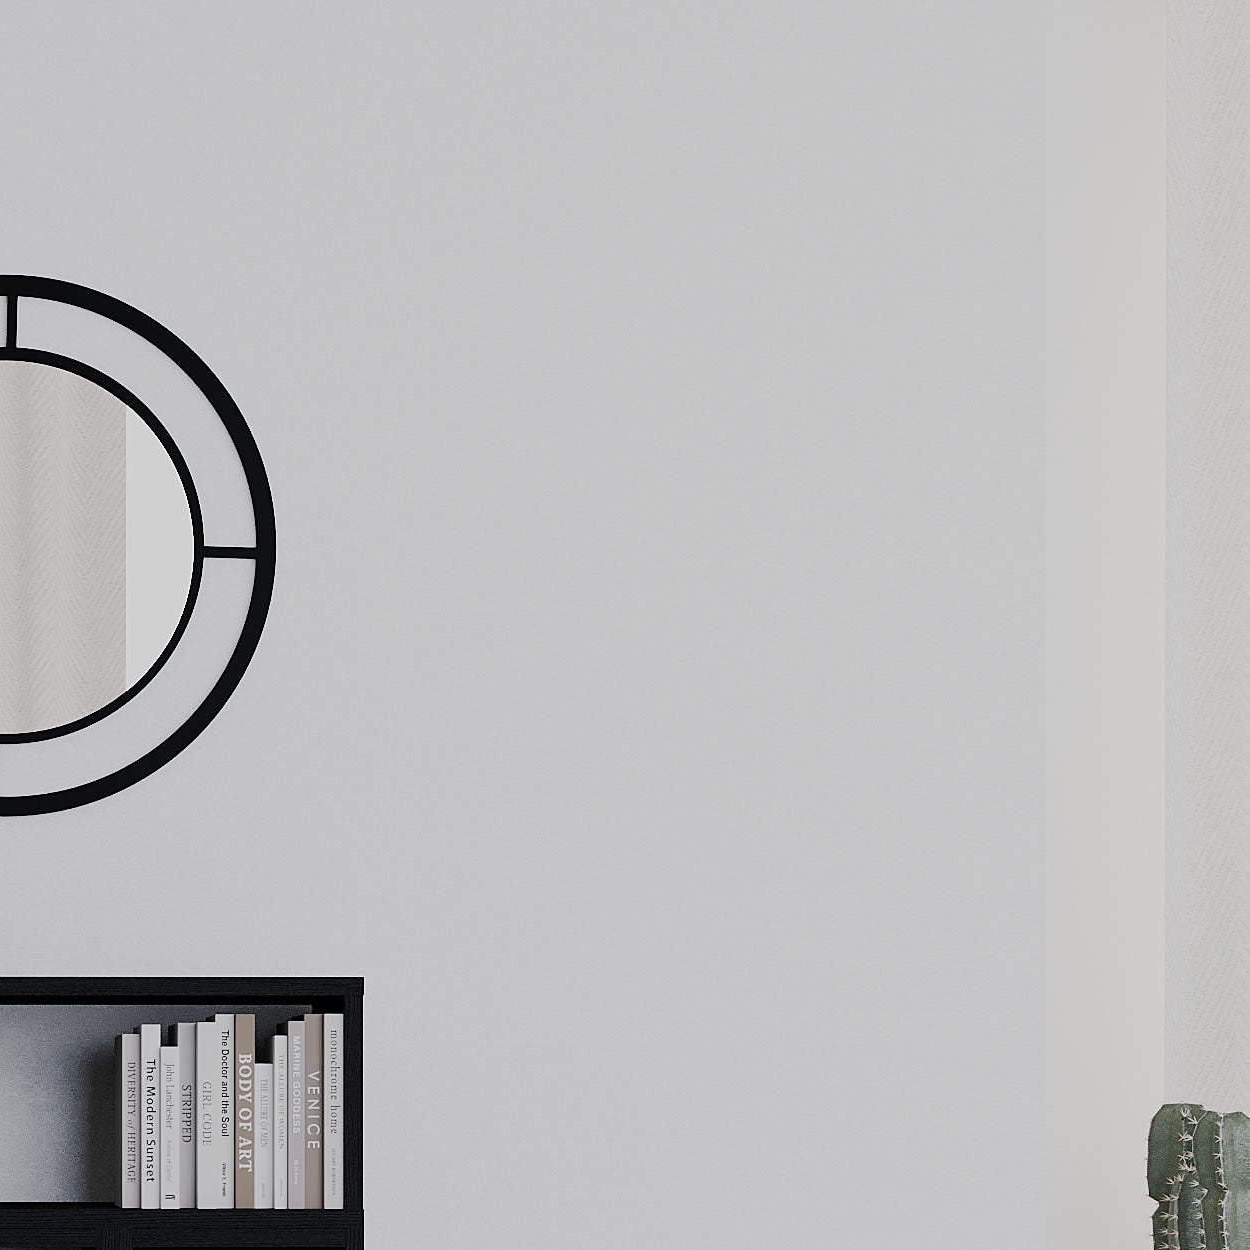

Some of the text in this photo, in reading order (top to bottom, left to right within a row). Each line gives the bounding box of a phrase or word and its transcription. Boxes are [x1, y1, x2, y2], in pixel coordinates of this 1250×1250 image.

[127, 1062, 136, 1184] DIVERSITY of HERITAGE
[146, 1059, 157, 1182] The Modern Sunset
[164, 1064, 175, 1129] John Lanchester
[182, 1084, 192, 1144] STRIPPED
[203, 1081, 212, 1147] GIRL CODE
[221, 1030, 230, 1138] The Doctor and the Soul
[239, 1053, 252, 1173] BODY OF ART
[260, 1079, 268, 1148] THE ALLURE OF MEN
[279, 1106, 285, 1116] OF
[293, 1036, 301, 1134] MARINE GODDESS
[308, 1071, 321, 1149] VENICE
[331, 1030, 340, 1135] monochrome home
